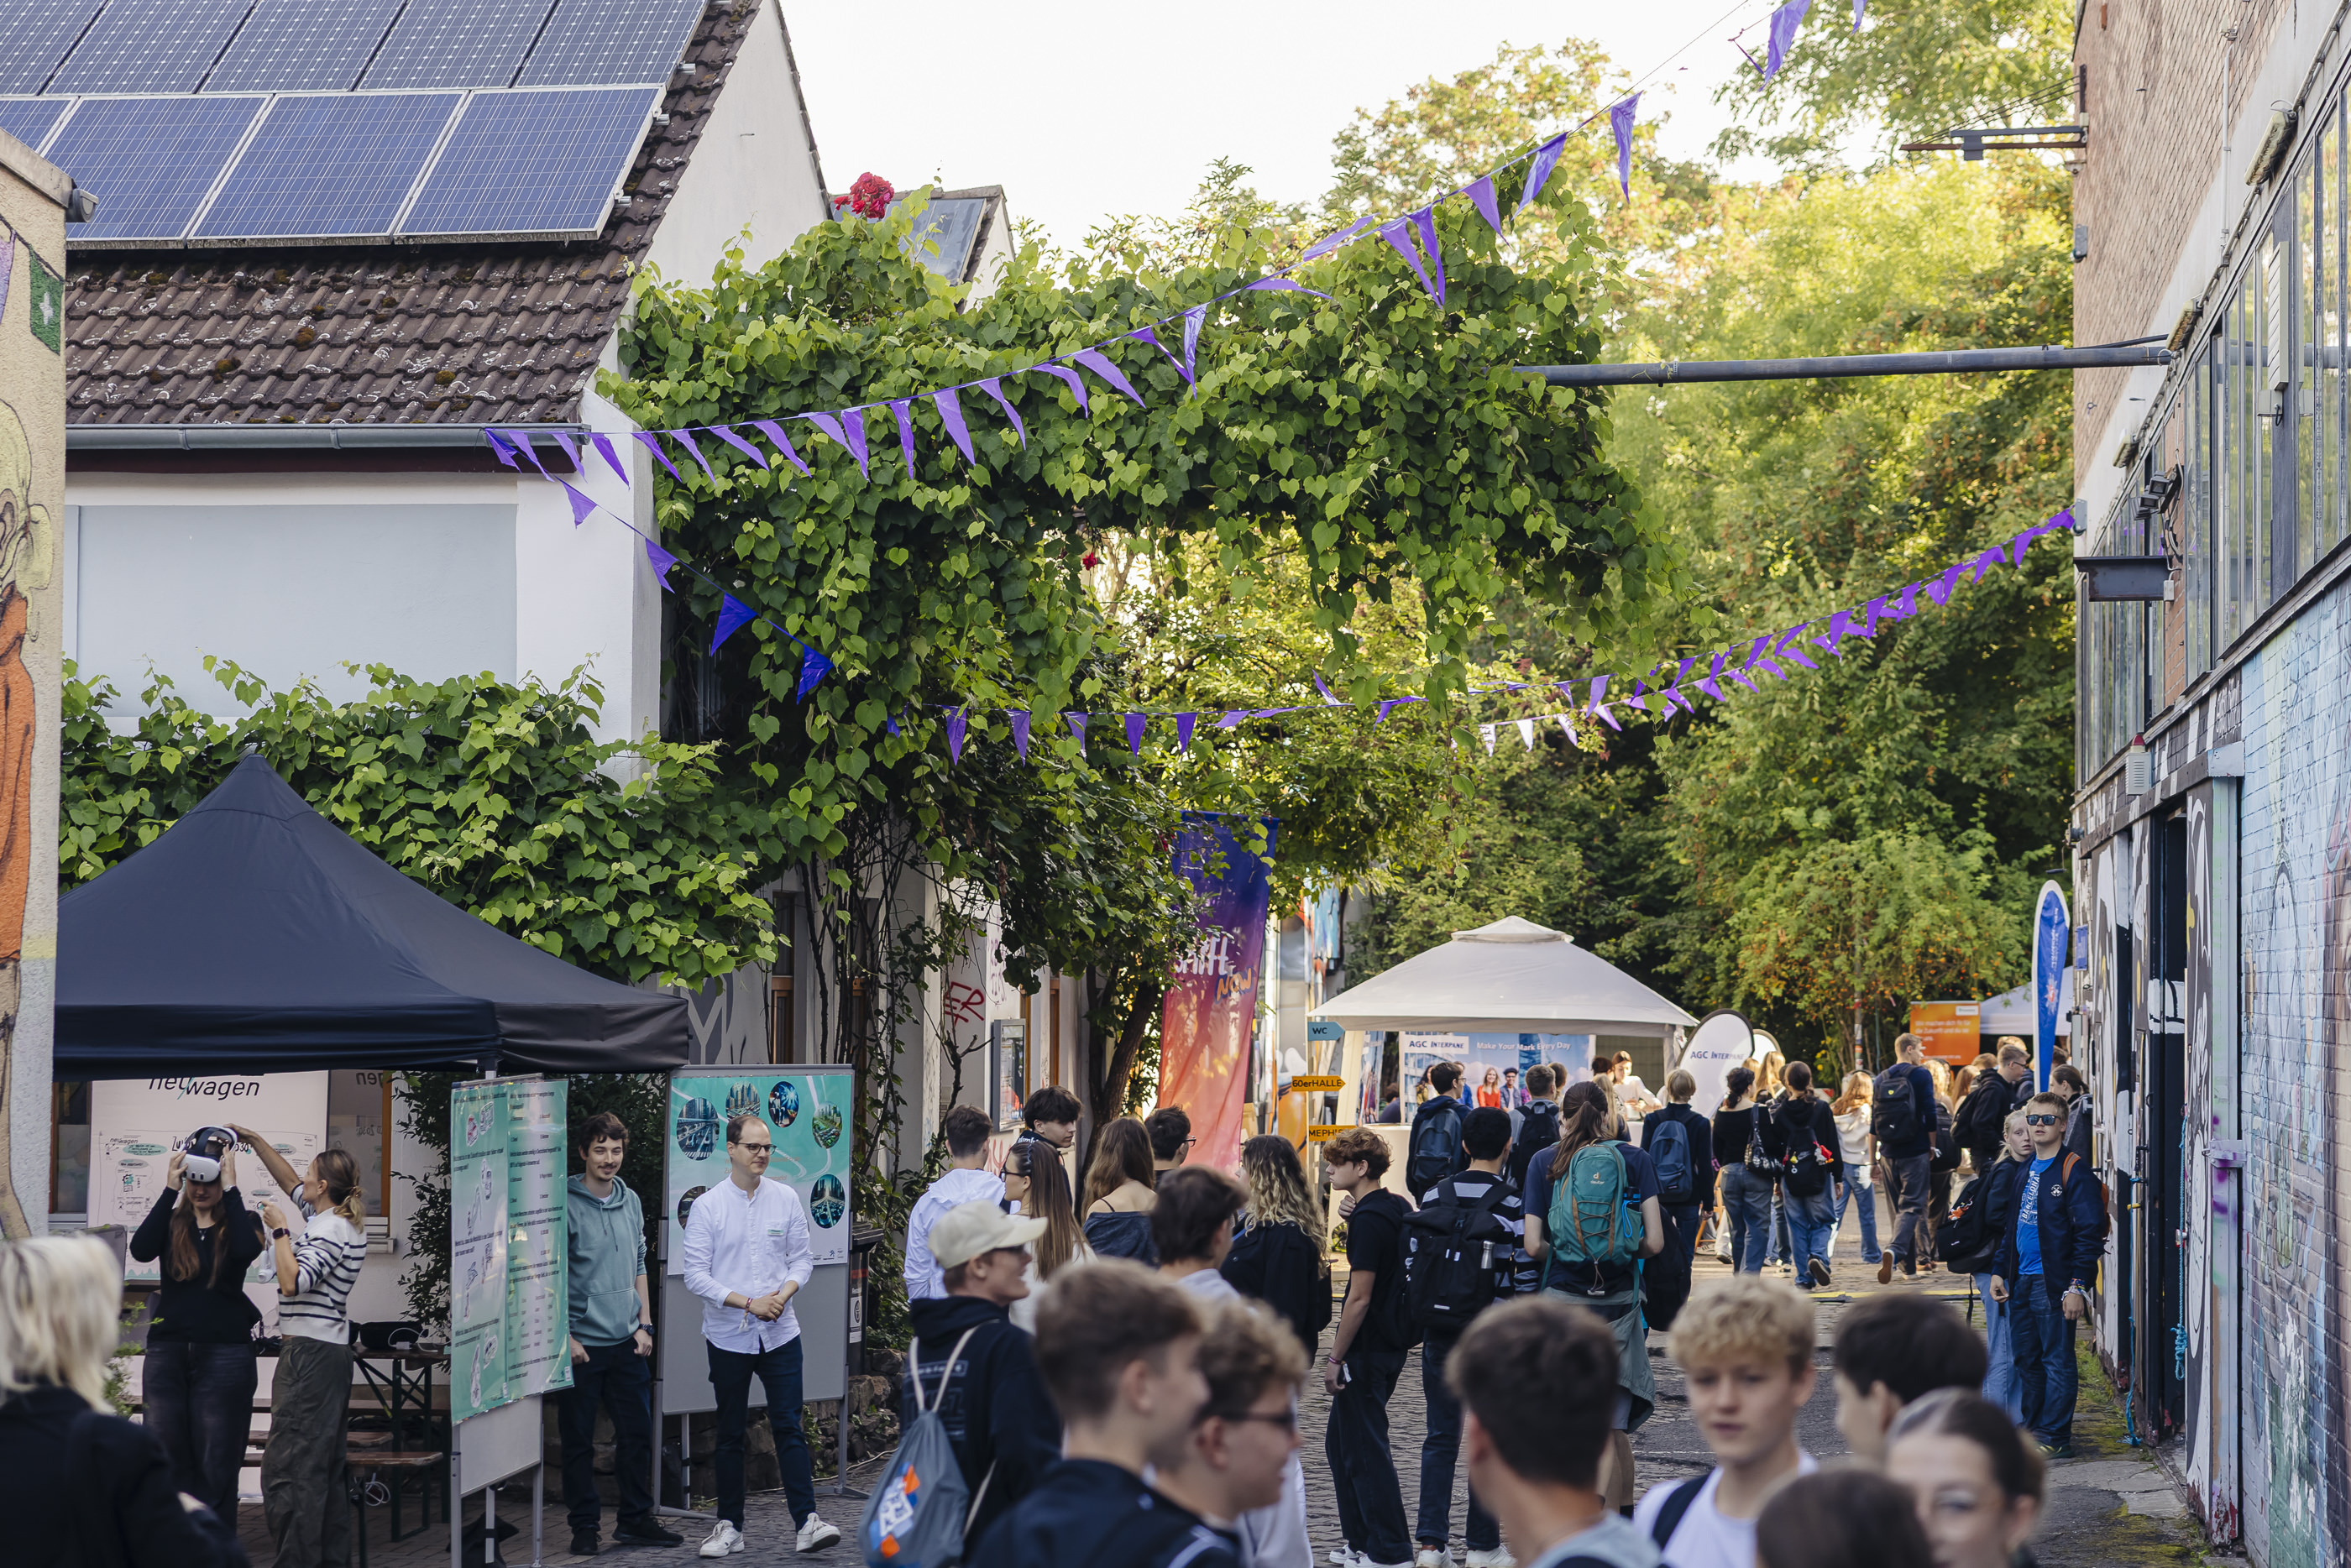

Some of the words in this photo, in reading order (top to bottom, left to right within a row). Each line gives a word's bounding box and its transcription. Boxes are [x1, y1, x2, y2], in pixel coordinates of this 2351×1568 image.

[1216, 967, 1252, 1002] NOW
[1312, 1027, 1328, 1035] WC
[1409, 1040, 1427, 1048] AGC
[1557, 1042, 1571, 1050] Day
[1690, 1051, 1709, 1059] AGC
[1292, 1079, 1343, 1088] 60erHALLE
[2022, 1176, 2040, 1220] BARCELONA
